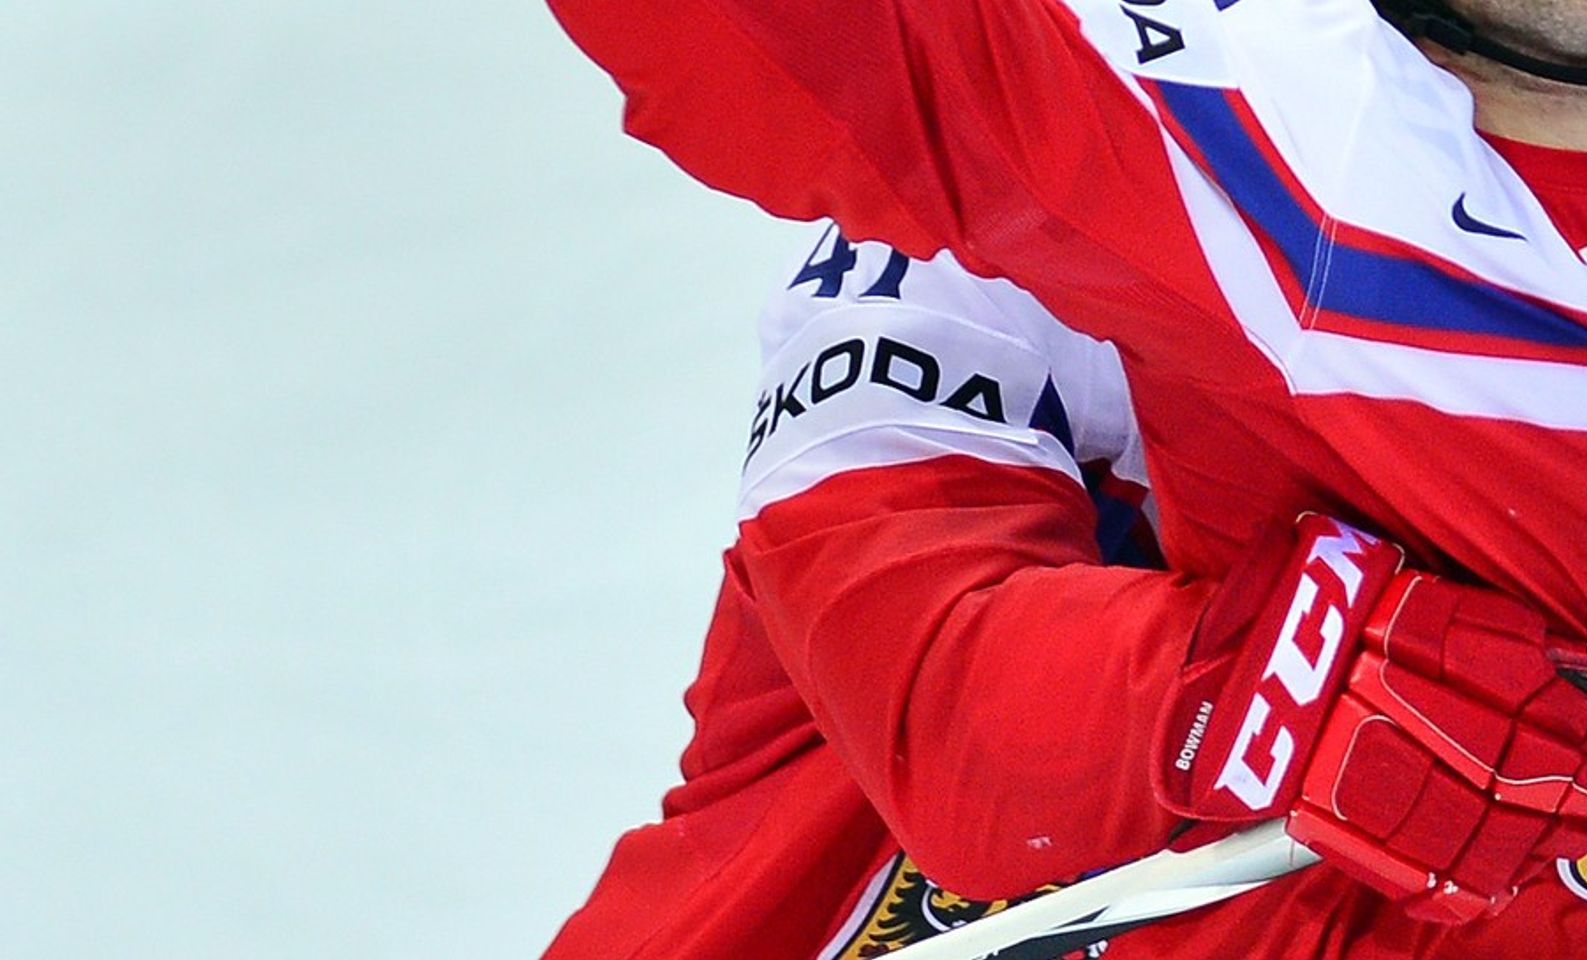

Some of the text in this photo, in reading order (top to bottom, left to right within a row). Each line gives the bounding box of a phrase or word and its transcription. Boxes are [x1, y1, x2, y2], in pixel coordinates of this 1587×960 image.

[742, 336, 1008, 473] ŠKODA
[1212, 517, 1382, 811] CCM
[1174, 700, 1214, 772] BOWMAN
